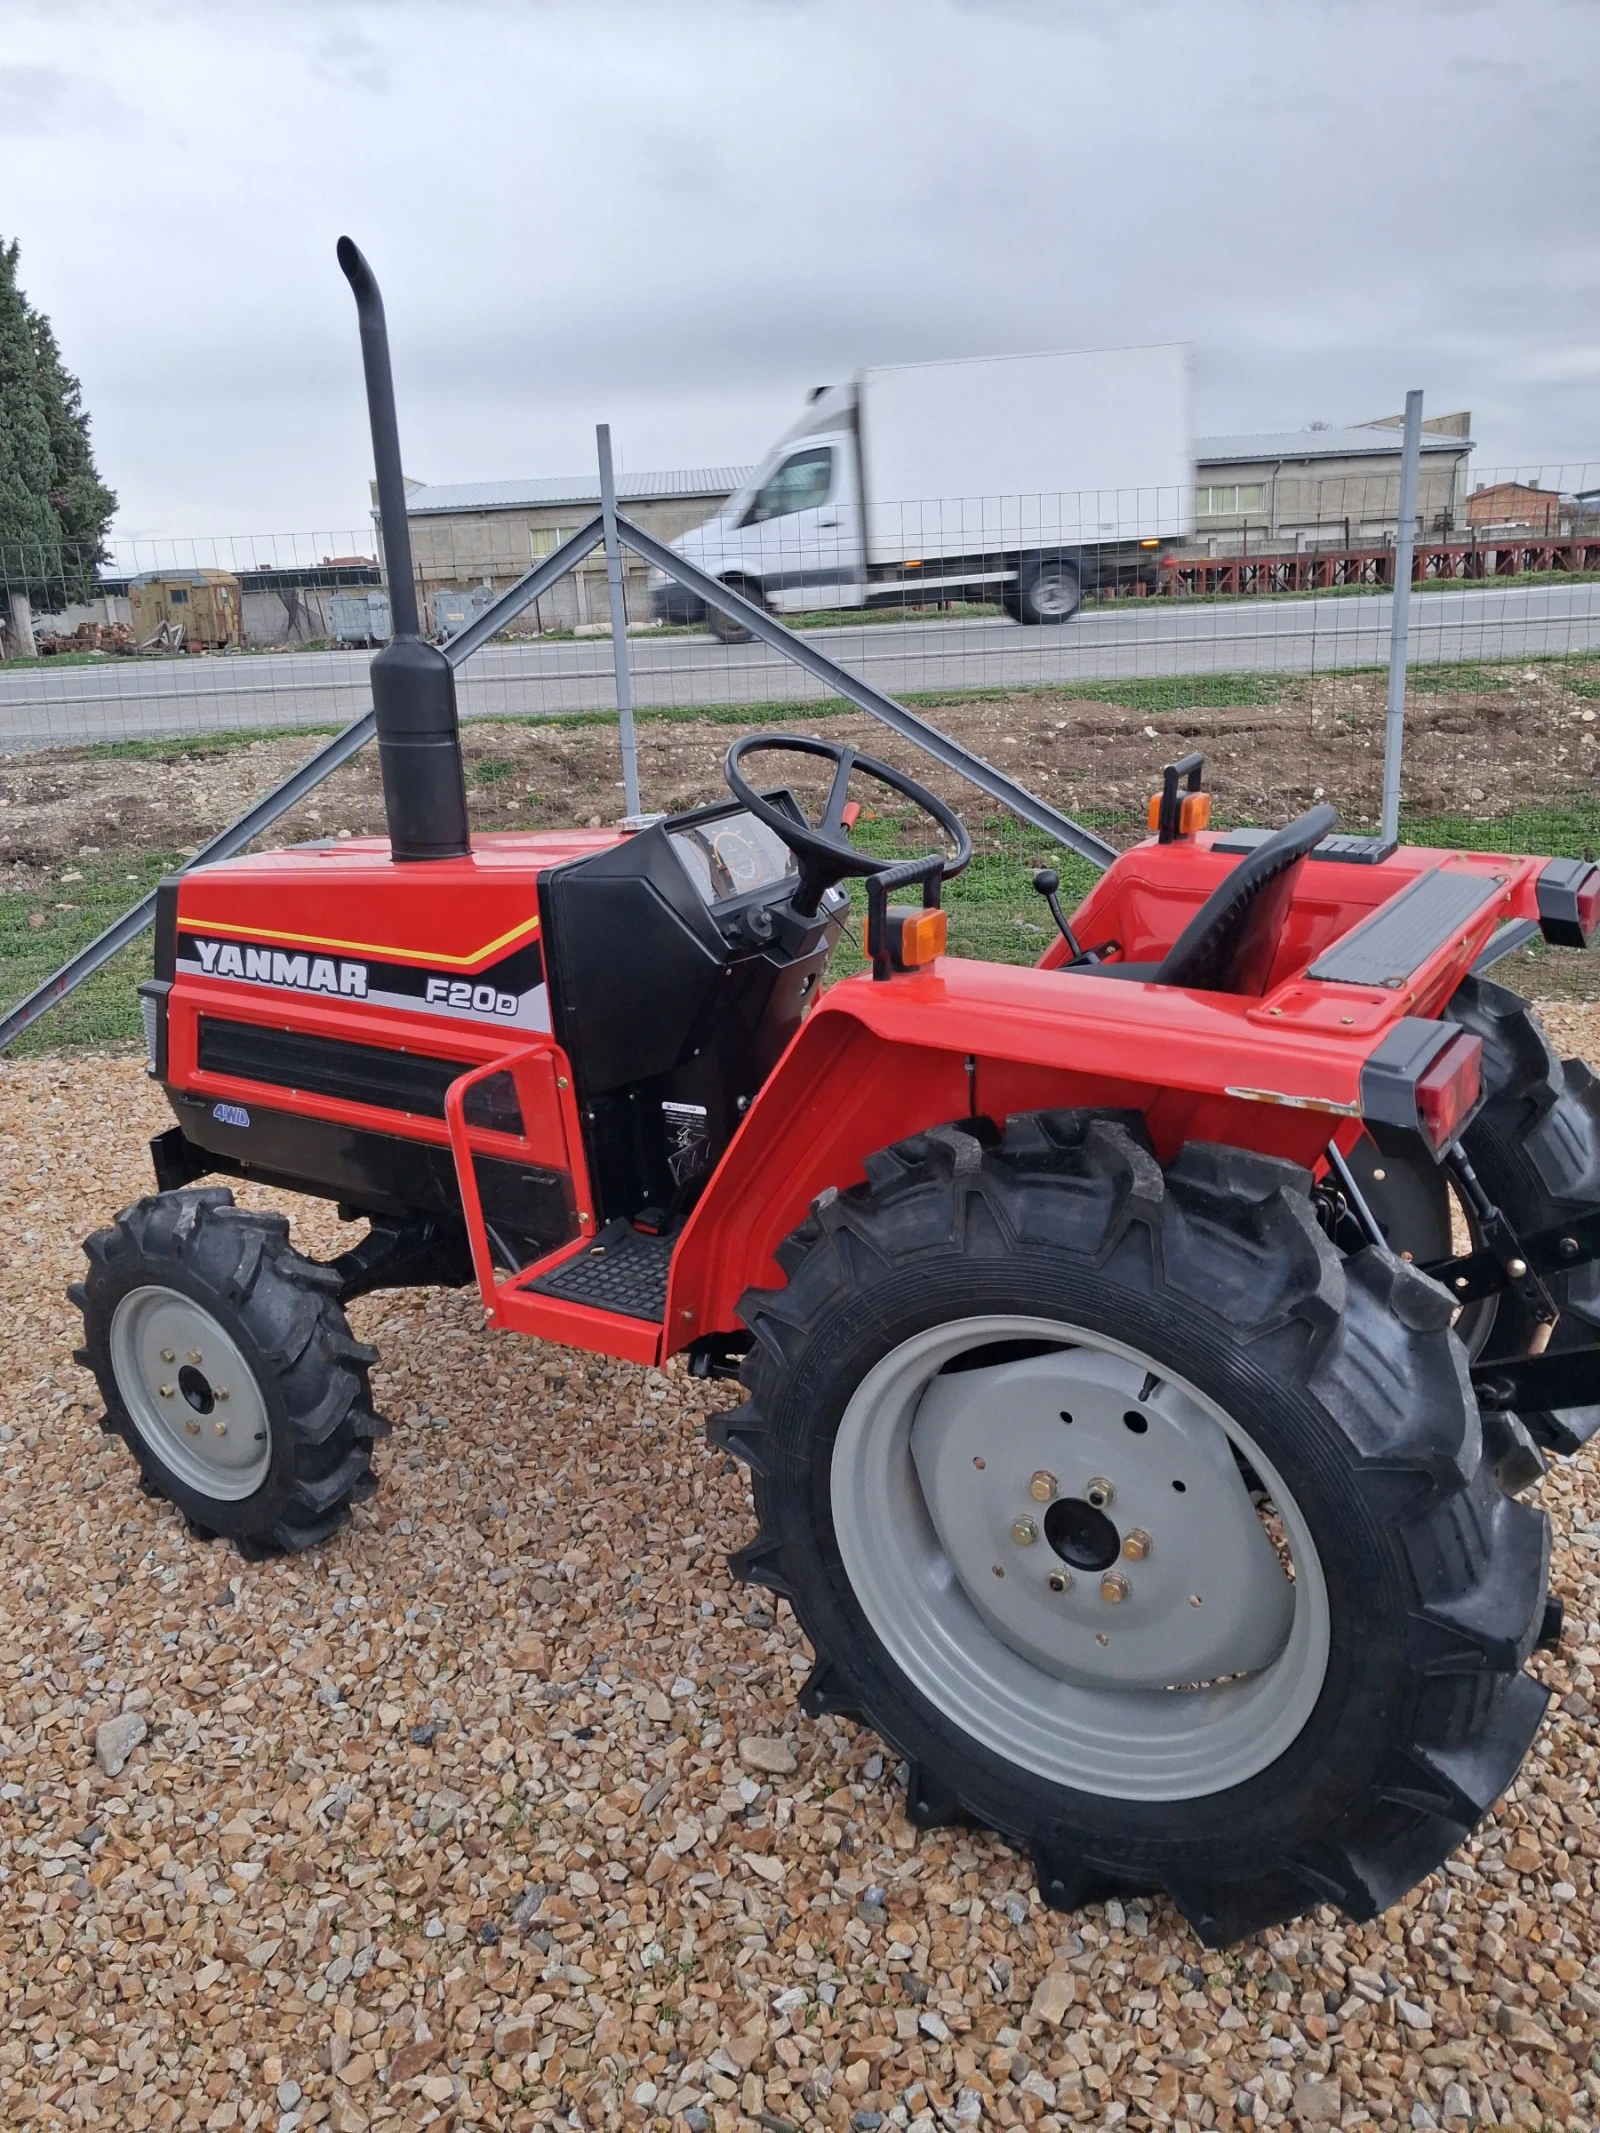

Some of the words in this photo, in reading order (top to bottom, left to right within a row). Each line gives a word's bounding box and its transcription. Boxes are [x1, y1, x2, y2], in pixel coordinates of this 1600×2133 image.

[194, 940, 368, 997] YANMAR
[425, 978, 518, 1015] F20D
[213, 1103, 250, 1127] 4WD
